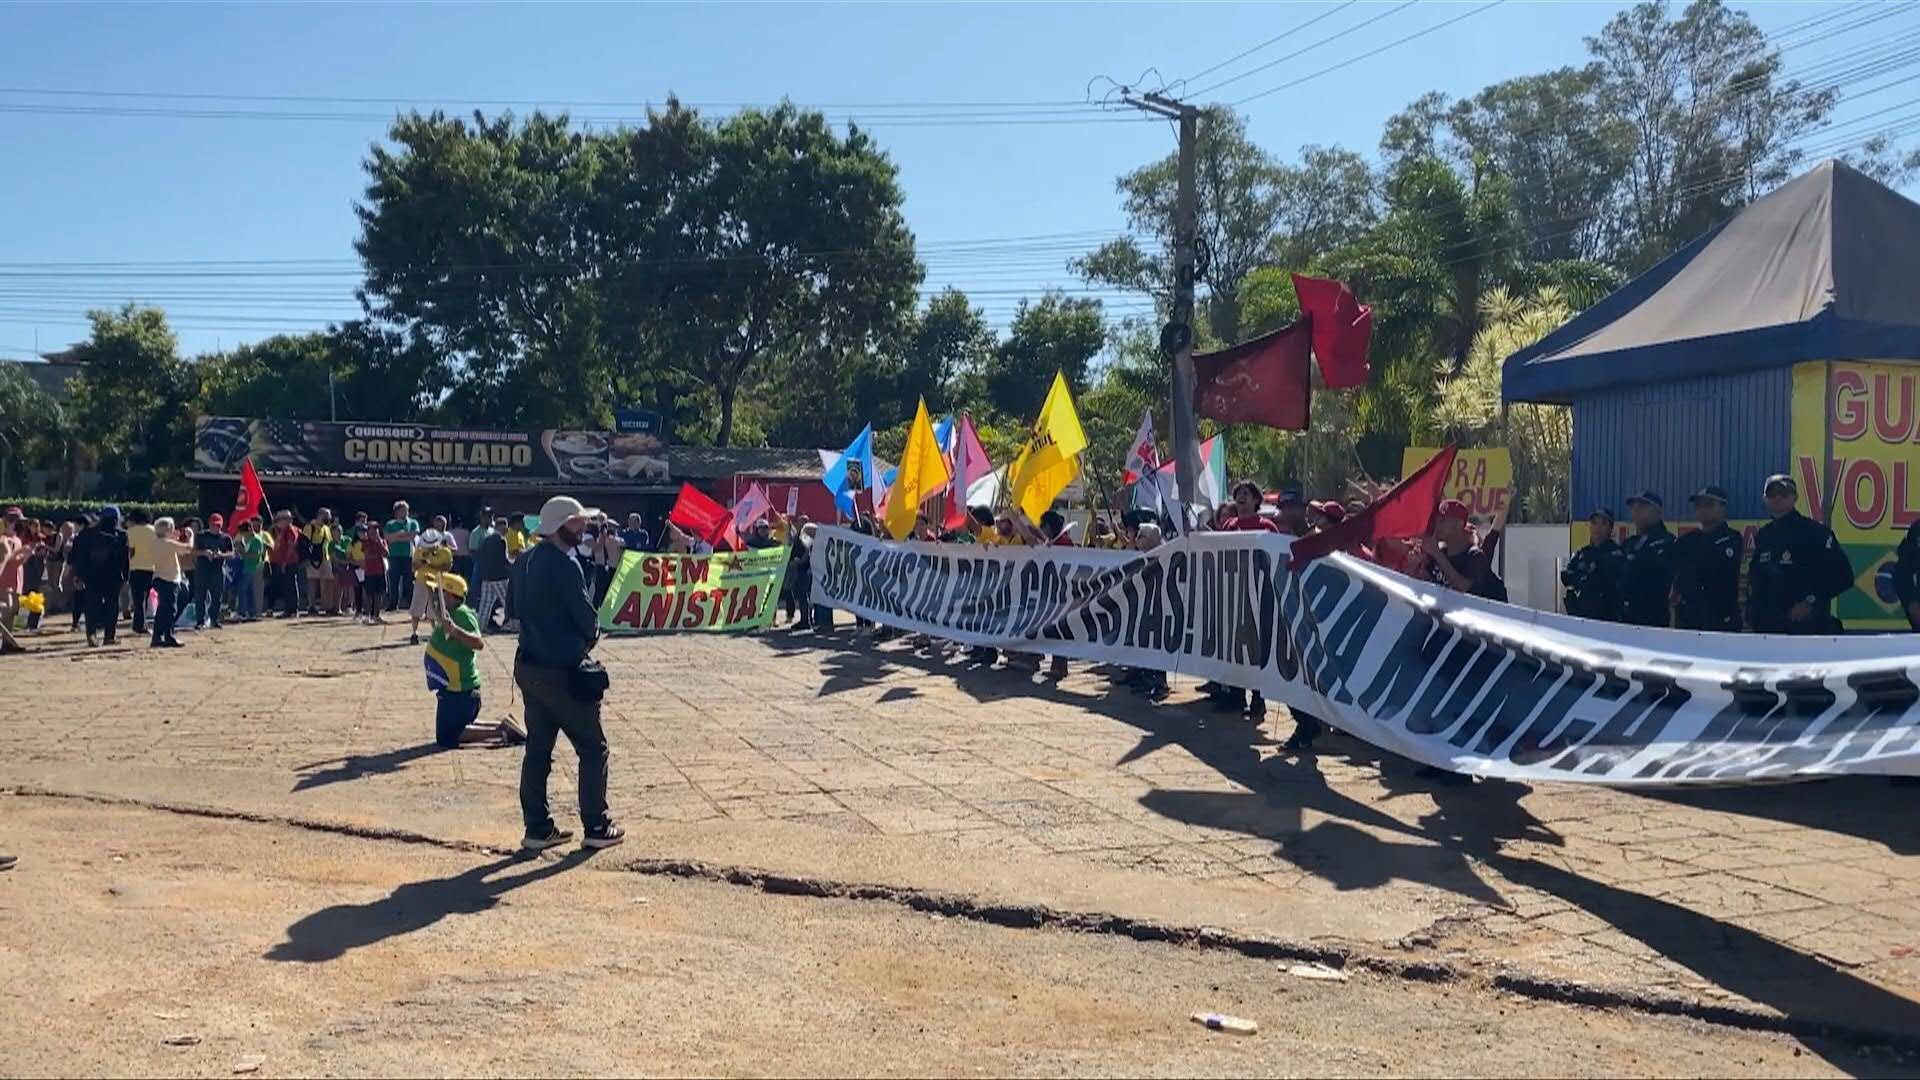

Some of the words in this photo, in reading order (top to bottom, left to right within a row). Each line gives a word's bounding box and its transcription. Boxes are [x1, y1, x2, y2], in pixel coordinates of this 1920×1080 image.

[1831, 370, 1920, 442] GU
[344, 439, 532, 467] CONSULADO
[1450, 457, 1488, 487] RA
[1797, 455, 1920, 529] VOL
[642, 555, 712, 587] SEM
[820, 536, 863, 603] SEM
[858, 548, 951, 625] ANISTIA
[942, 557, 1015, 637] PARA
[1008, 551, 1197, 655] GOLPISTAS!
[1200, 548, 1389, 707] DITADURA
[1358, 605, 1693, 776] NUNCA
